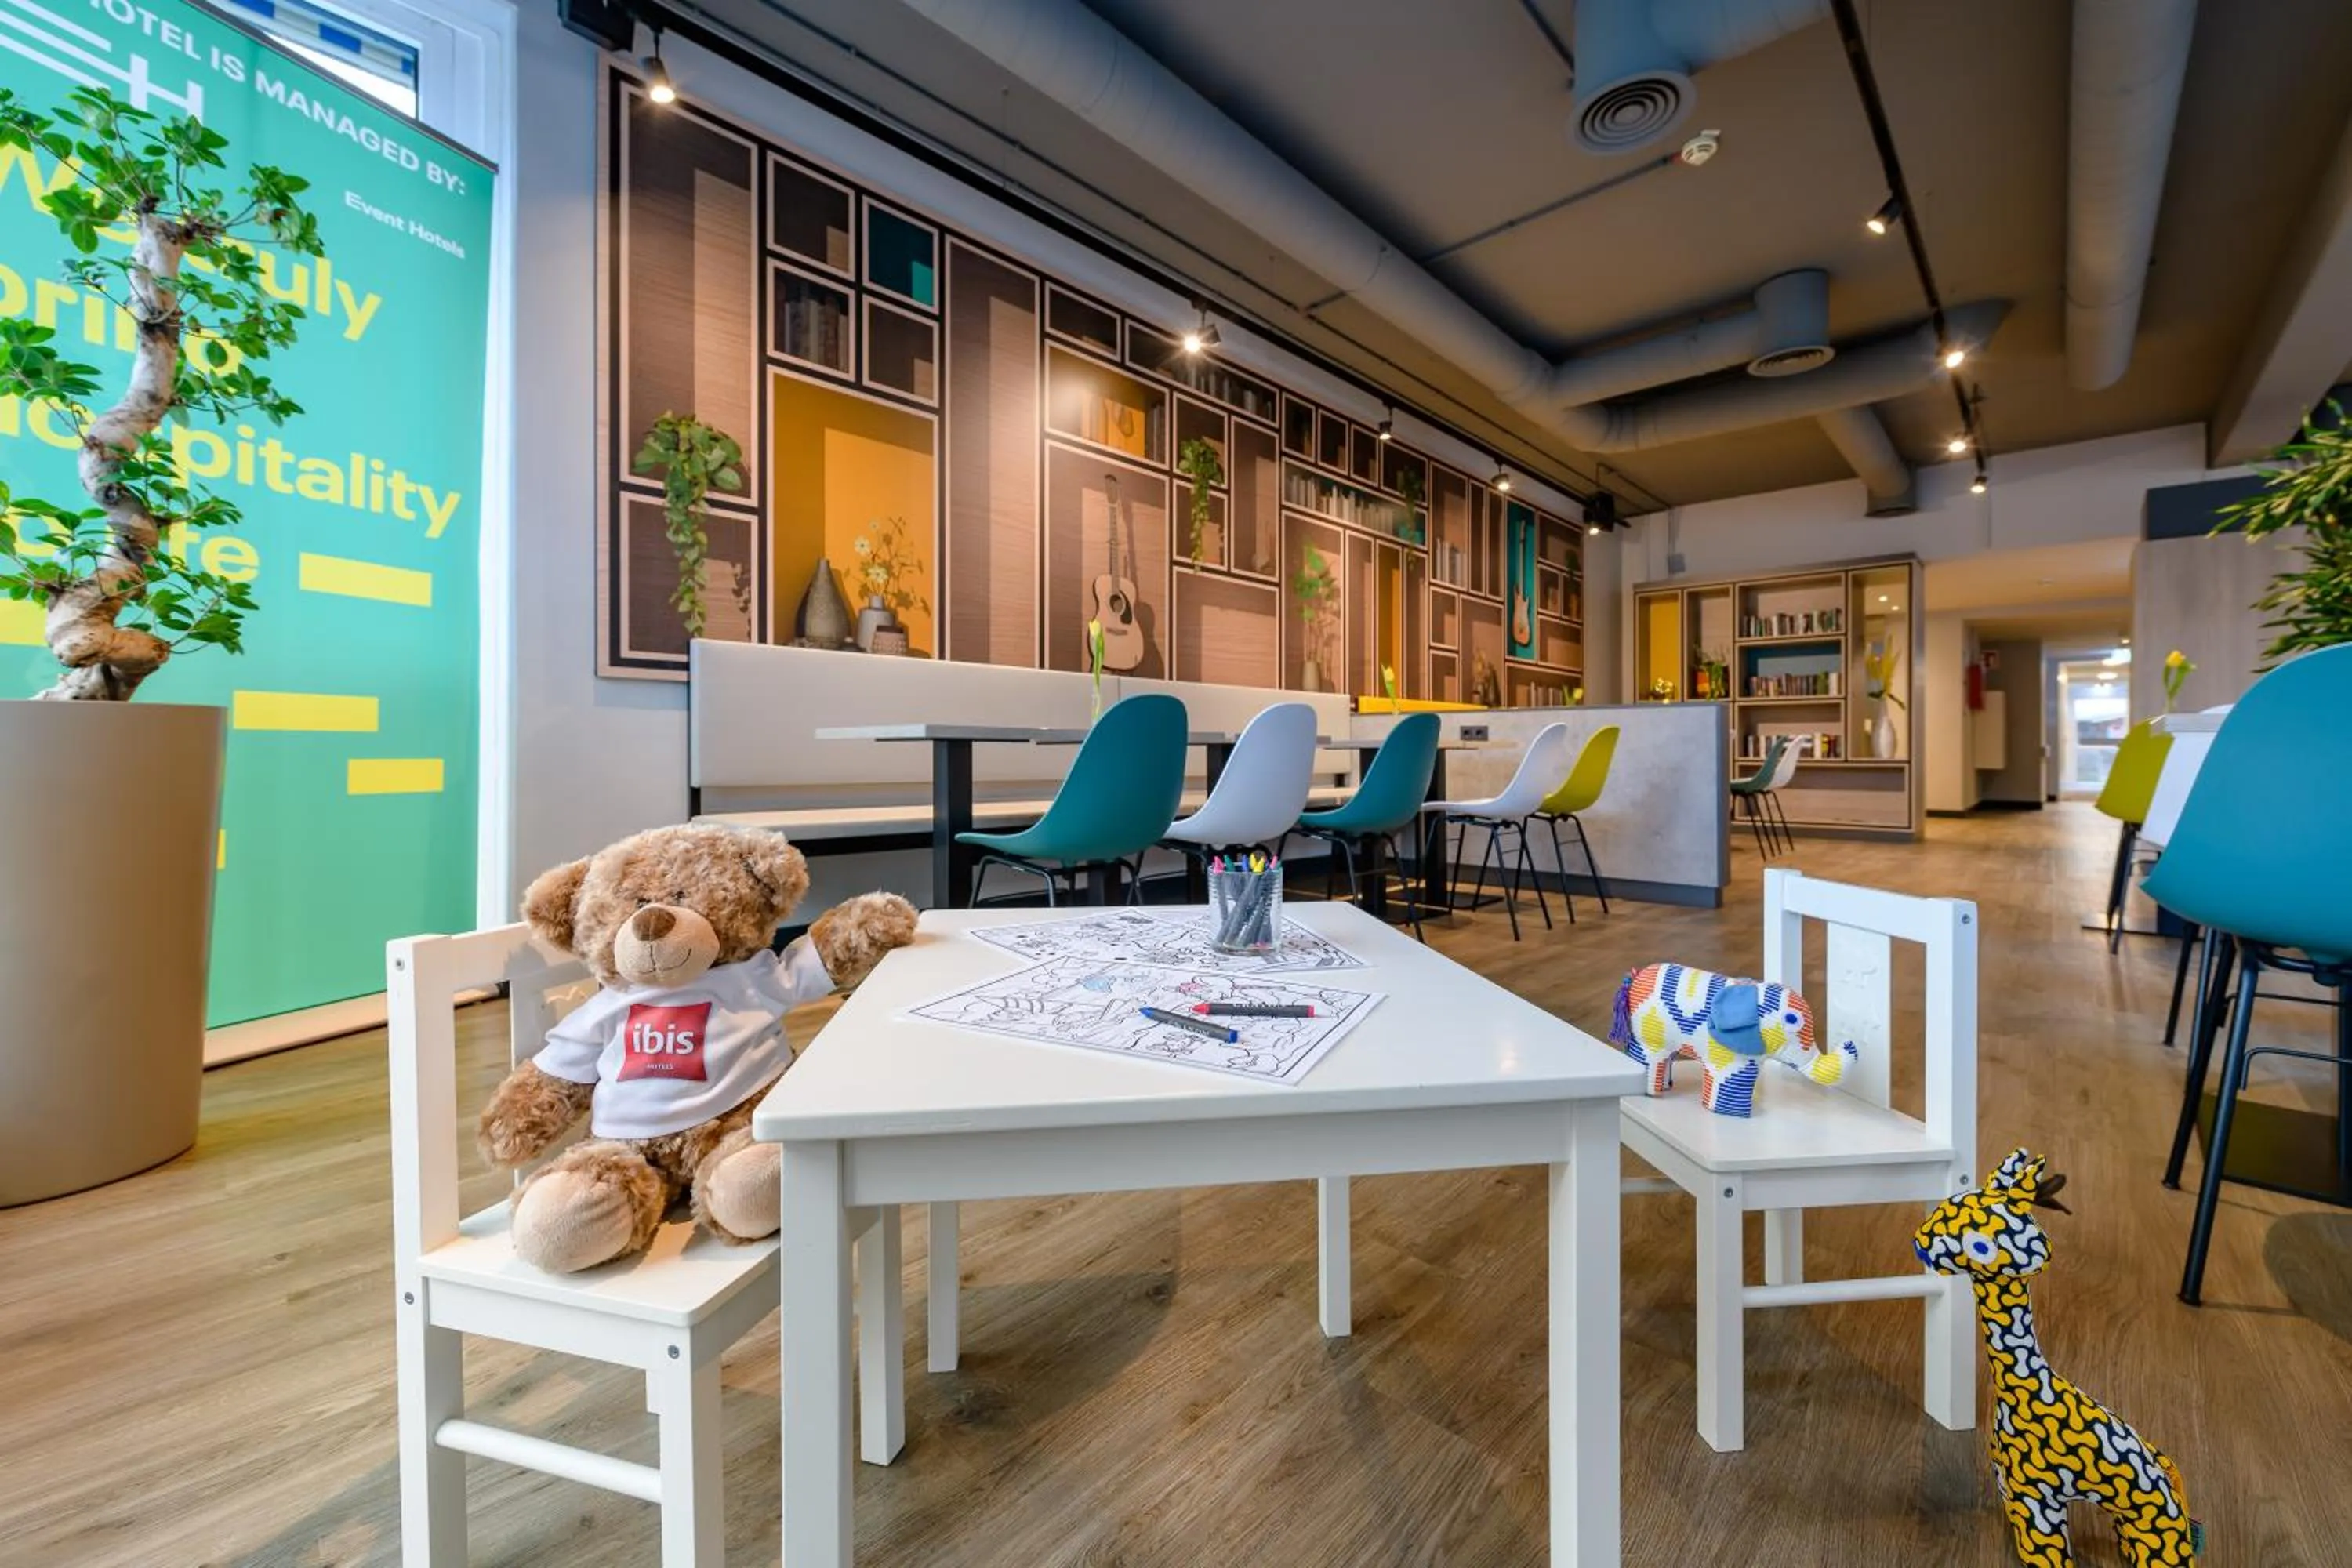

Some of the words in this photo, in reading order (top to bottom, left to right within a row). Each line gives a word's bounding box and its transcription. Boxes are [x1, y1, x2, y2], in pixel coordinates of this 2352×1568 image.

[89, 0, 201, 60] OTEL
[210, 45, 246, 82] IS
[255, 71, 420, 172] MANAGED
[426, 160, 466, 196] BY:
[344, 191, 405, 233] Event
[409, 220, 466, 259] Hotels
[0, 389, 462, 539] opitality
[633, 1022, 695, 1055] ibis
